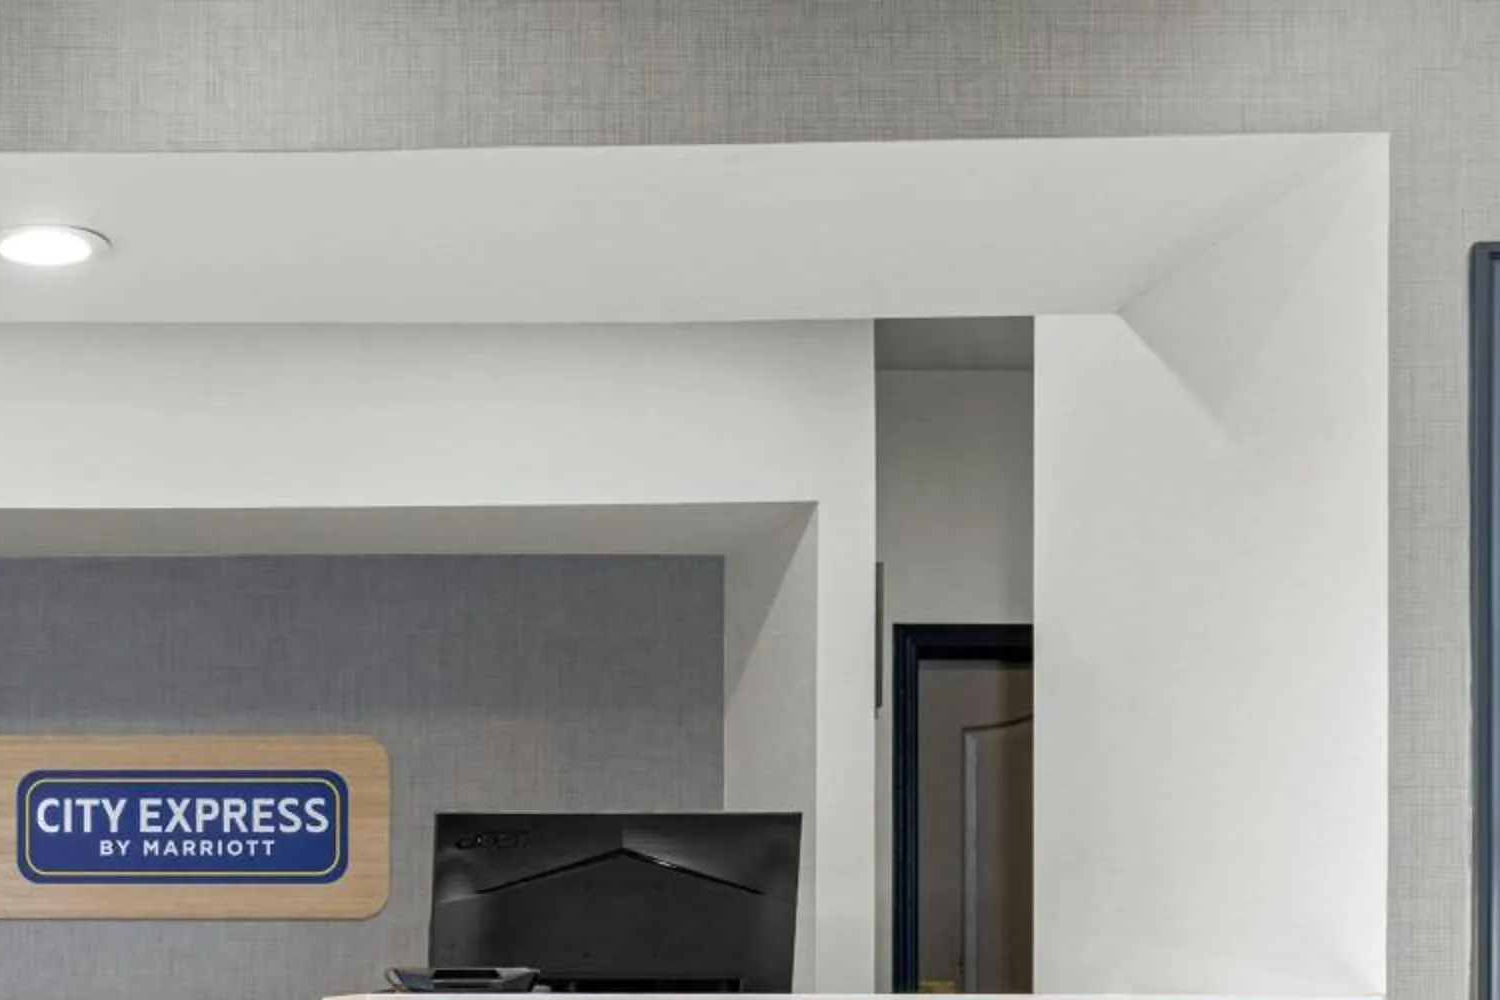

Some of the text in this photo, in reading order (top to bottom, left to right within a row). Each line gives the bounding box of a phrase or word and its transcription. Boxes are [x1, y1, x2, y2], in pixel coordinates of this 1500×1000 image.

[35, 797, 330, 833] CITY EXPRESS
[100, 839, 276, 856] BY MARRIOTT
